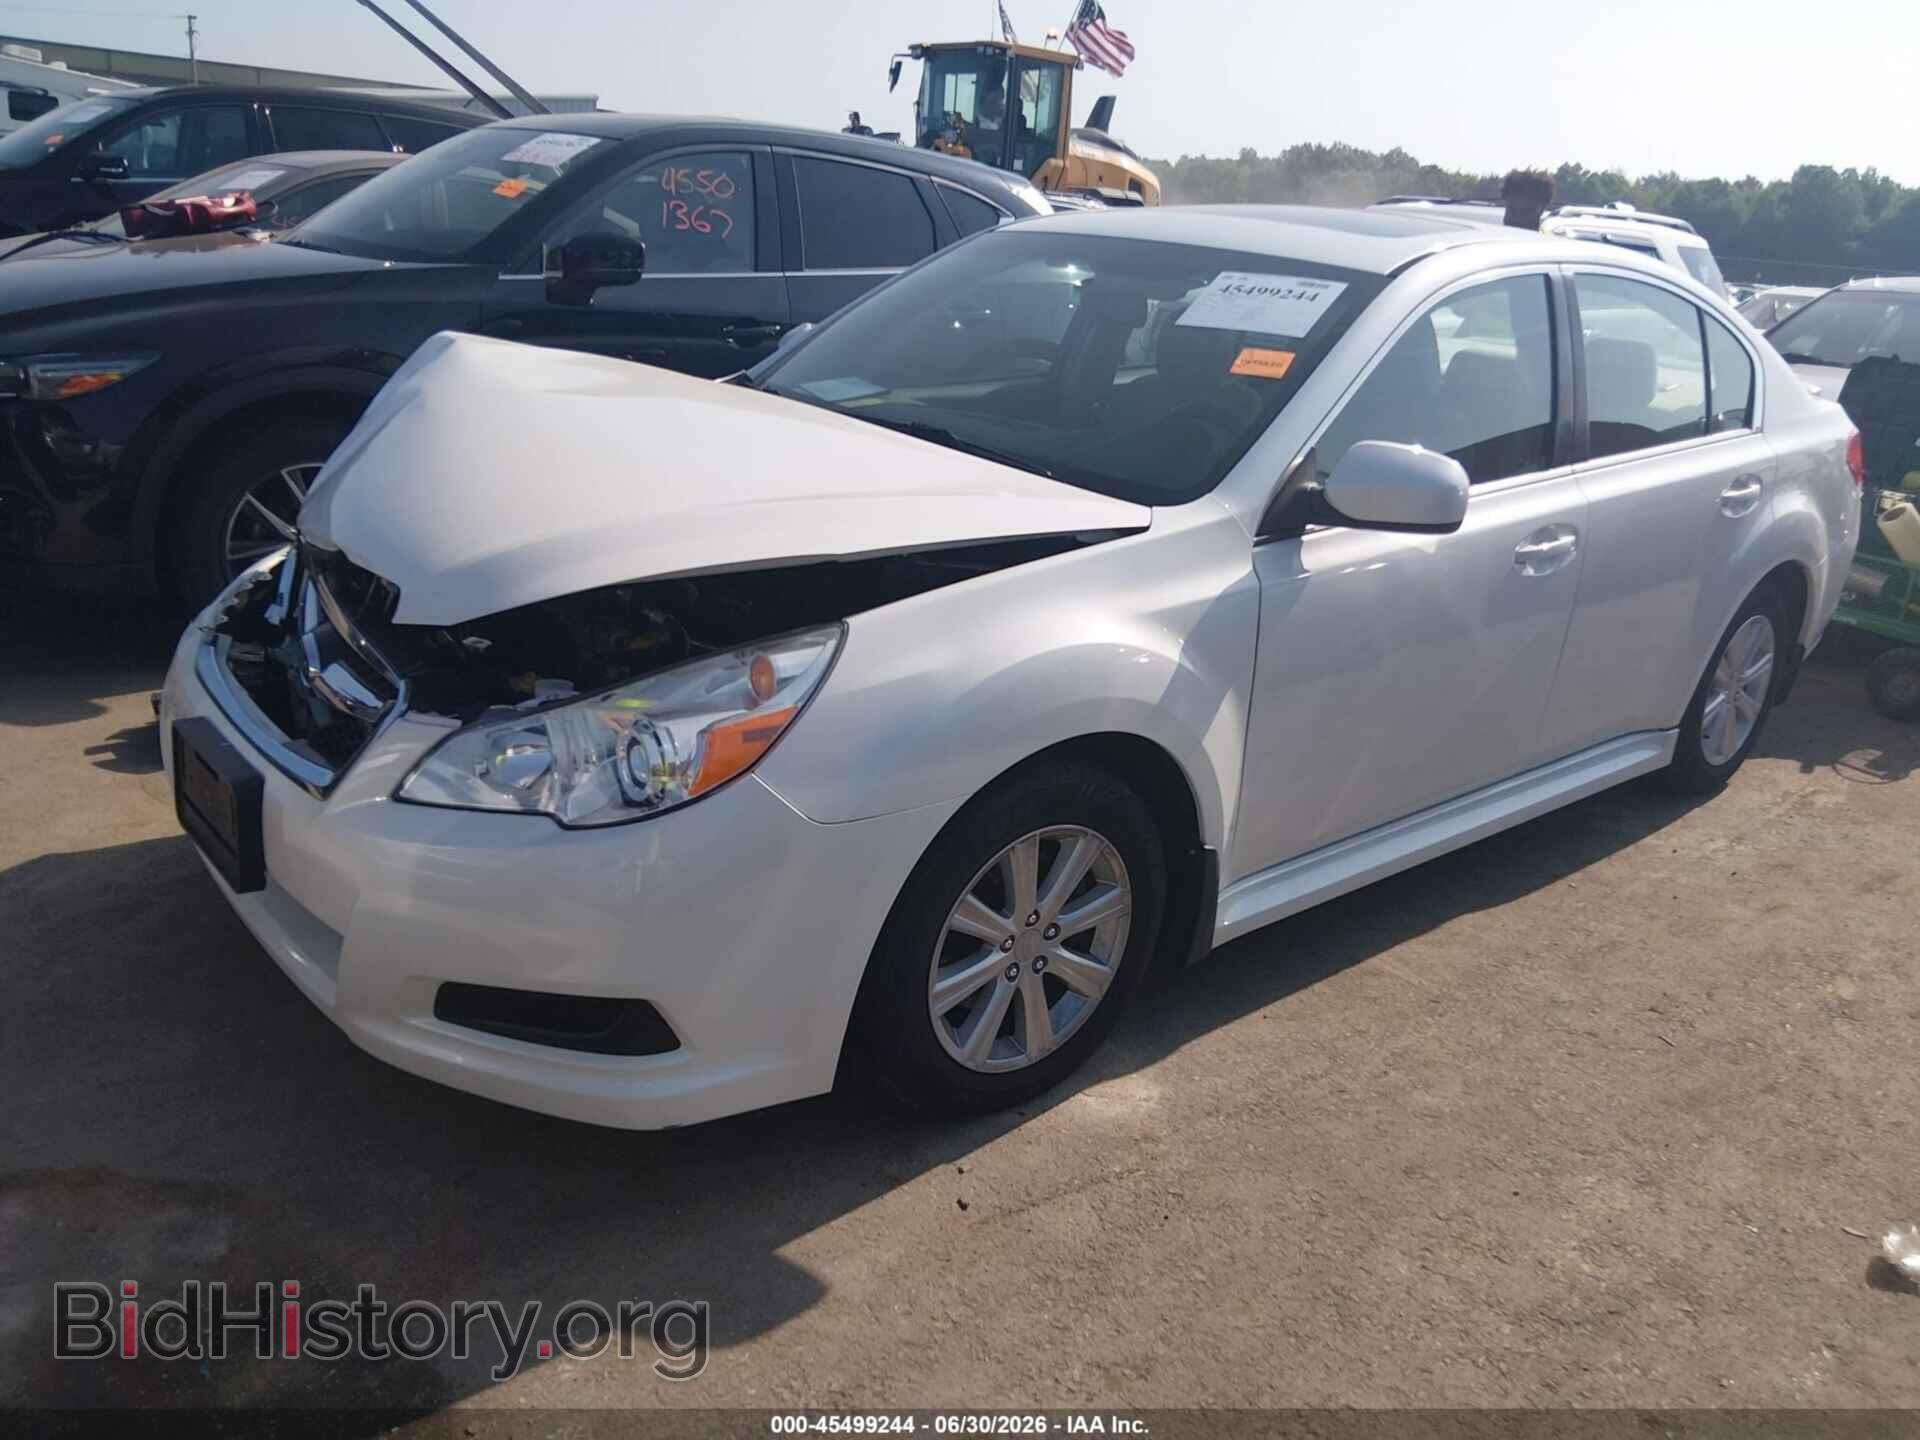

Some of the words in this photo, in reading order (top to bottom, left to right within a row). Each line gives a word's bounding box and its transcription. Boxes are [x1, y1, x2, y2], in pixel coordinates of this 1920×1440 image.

[661, 167, 736, 197] 4550
[661, 201, 734, 239] 1367
[1219, 283, 1320, 302] 45499244
